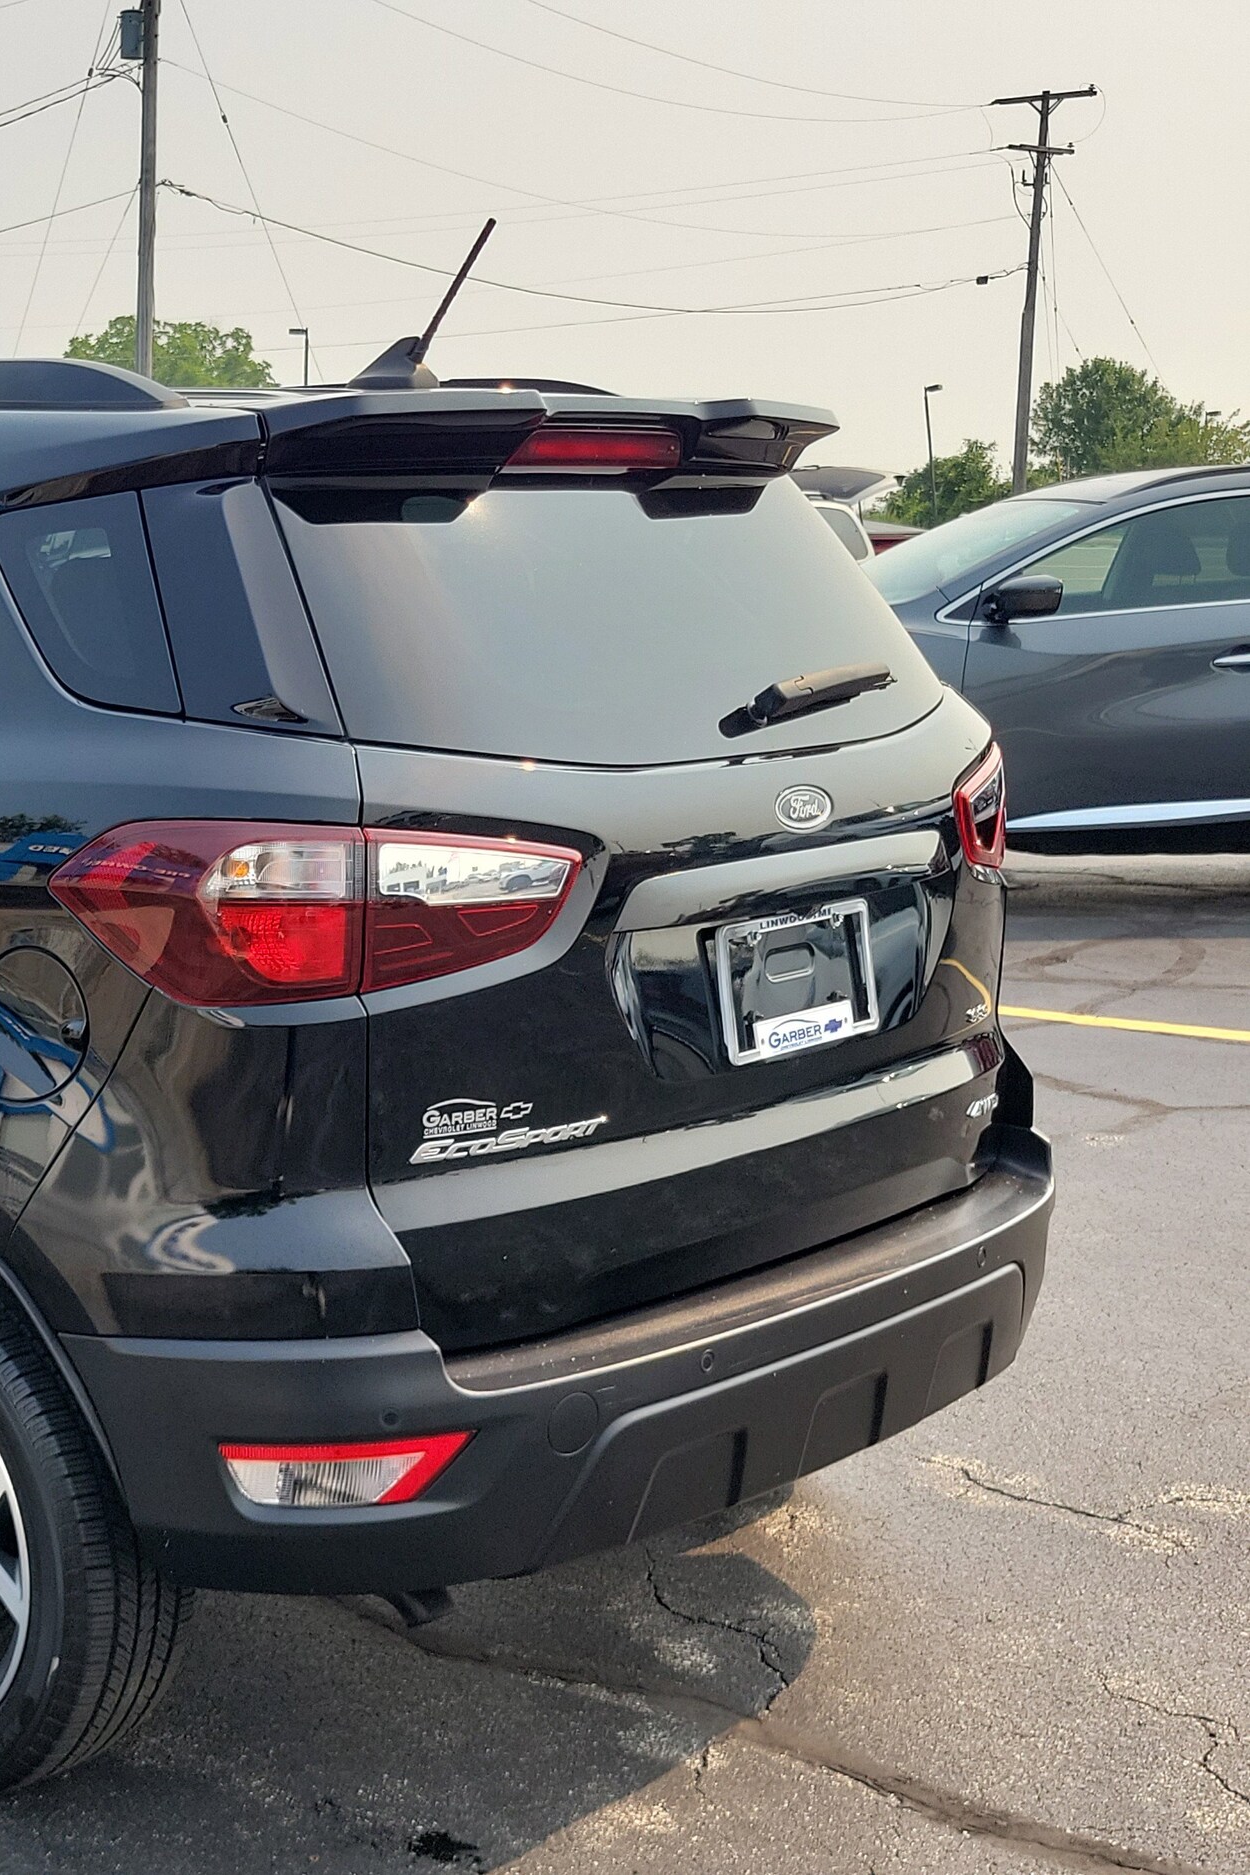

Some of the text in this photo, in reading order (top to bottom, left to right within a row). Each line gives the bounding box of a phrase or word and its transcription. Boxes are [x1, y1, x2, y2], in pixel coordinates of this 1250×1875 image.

[790, 795, 821, 819] Ford
[769, 1024, 822, 1048] GARBER
[423, 1107, 497, 1127] GARBER
[424, 1121, 497, 1135] CHEVROLET LINWOOD
